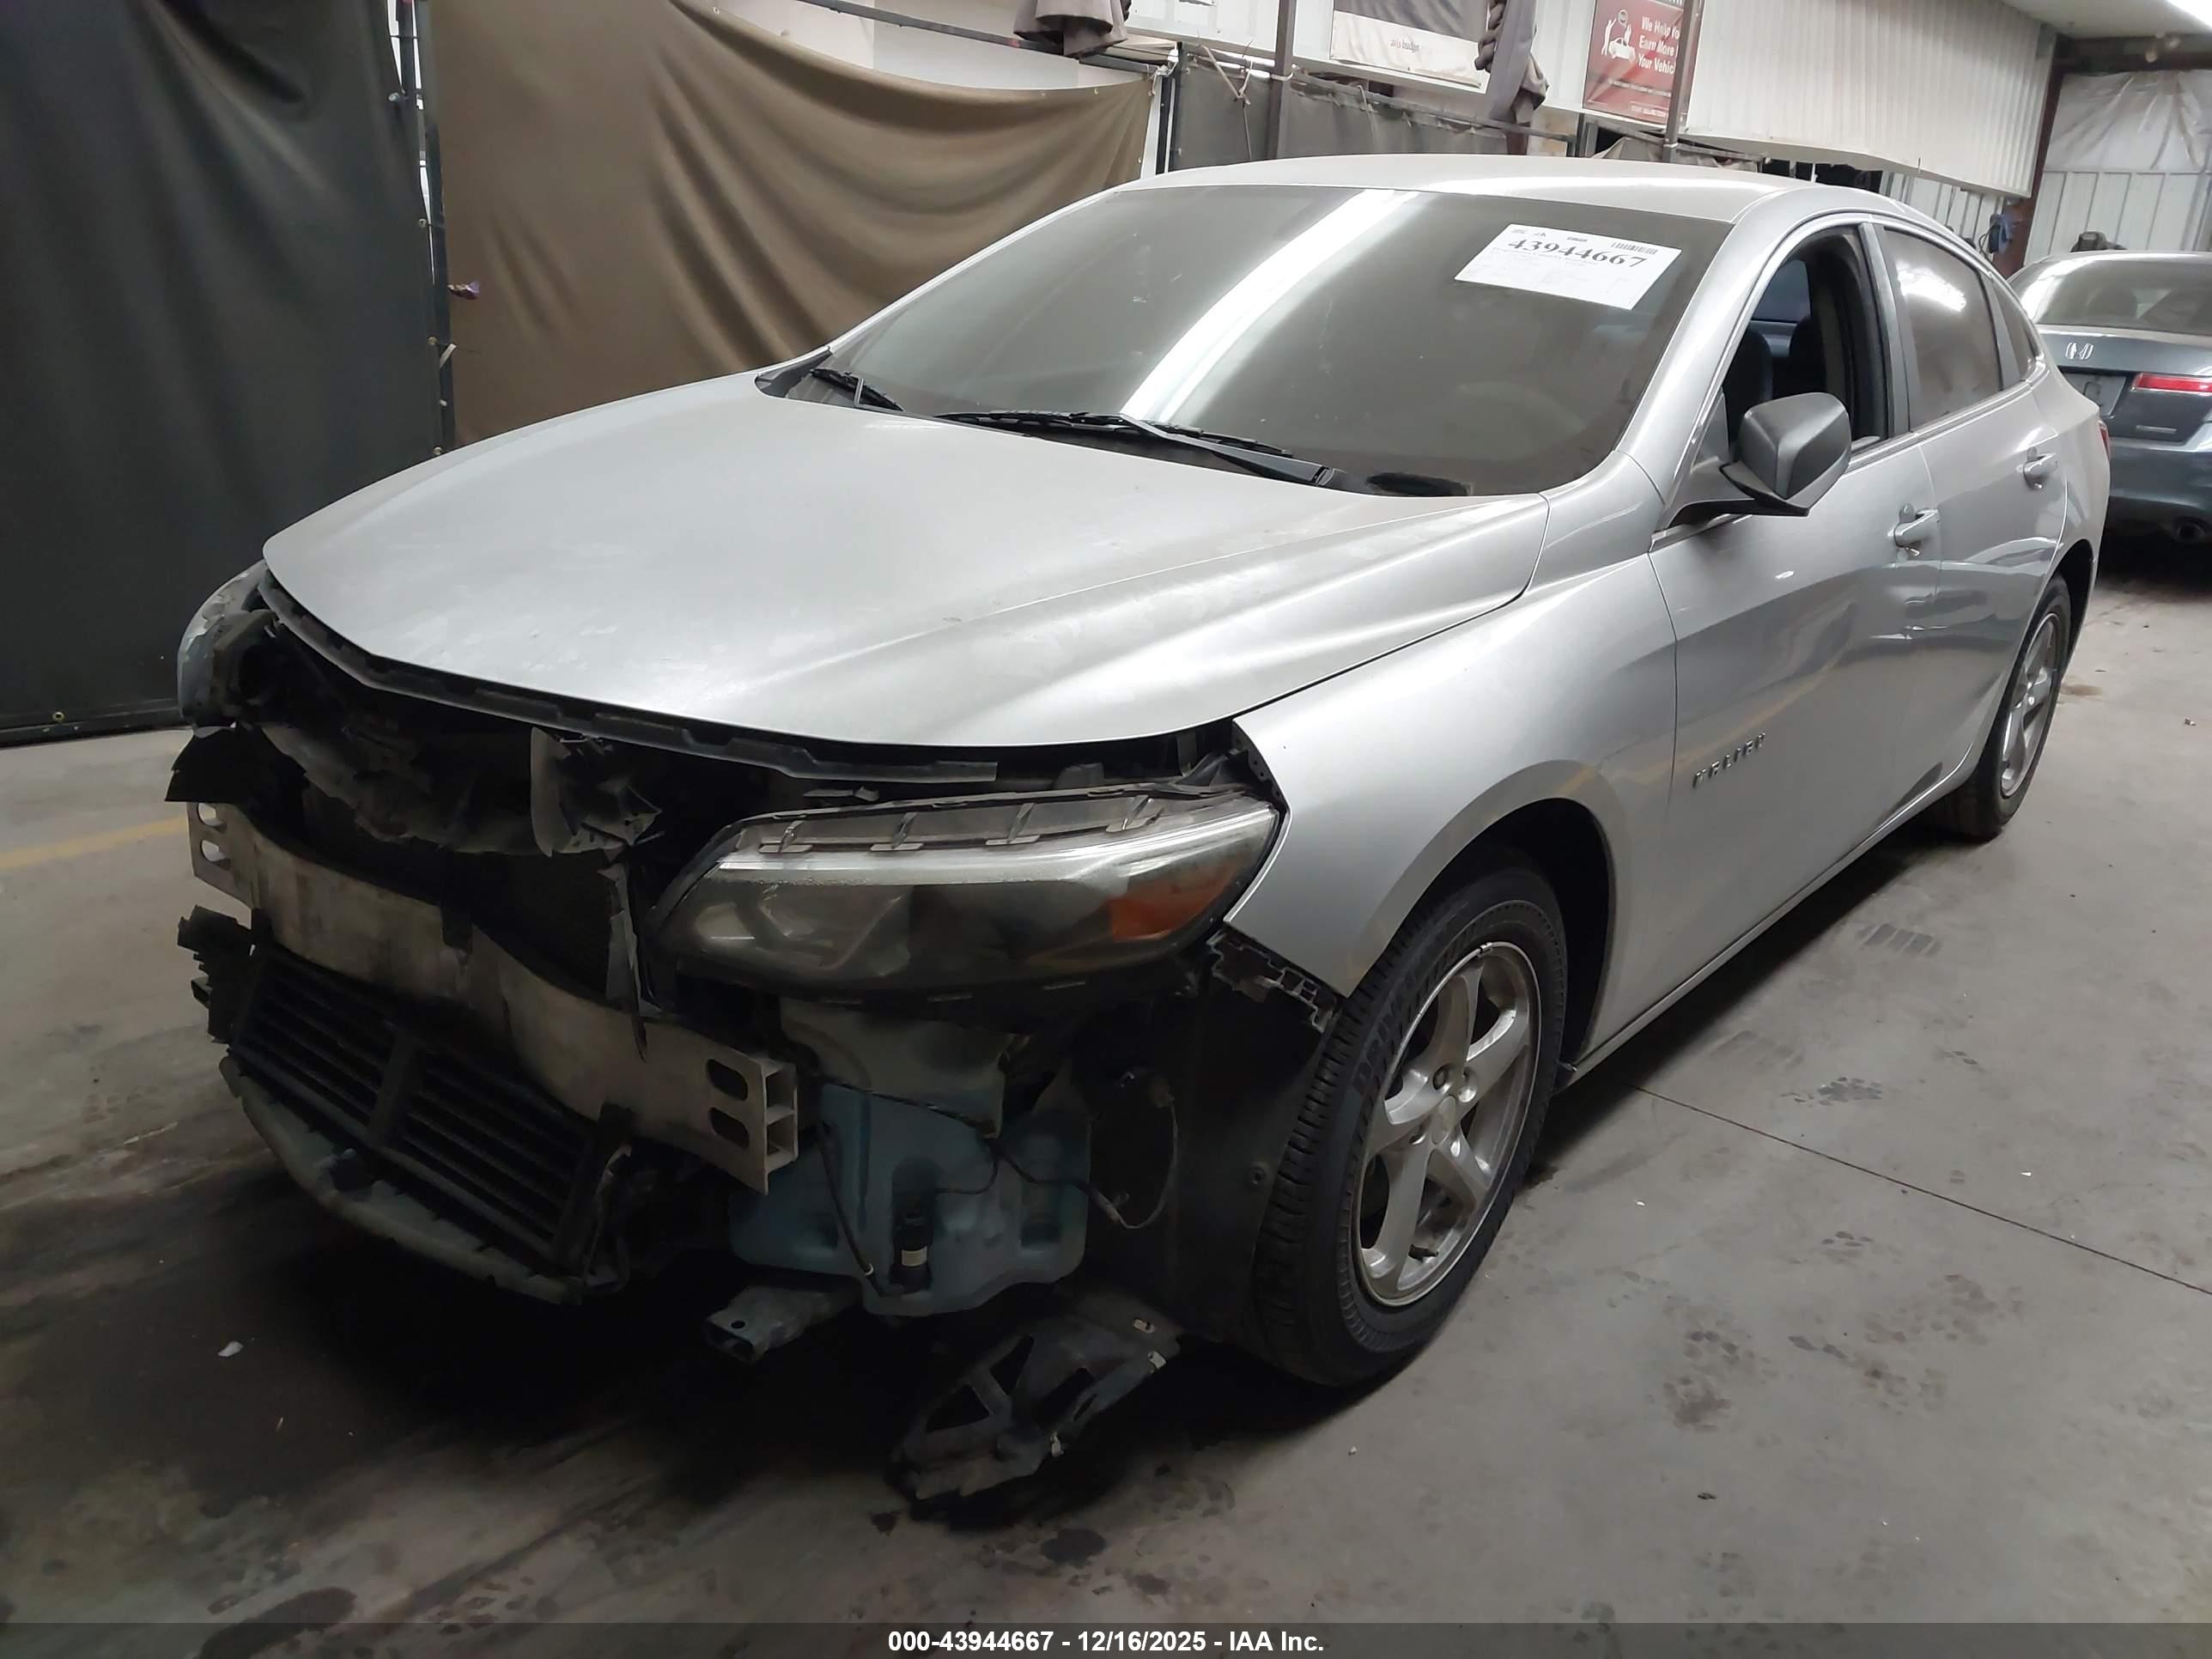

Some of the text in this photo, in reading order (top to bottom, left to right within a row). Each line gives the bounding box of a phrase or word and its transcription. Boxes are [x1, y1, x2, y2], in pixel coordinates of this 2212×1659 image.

[1641, 15, 1652, 32] We
[1639, 33, 1657, 51] Earn
[1656, 39, 1674, 57] More
[1638, 52, 1653, 70] Your
[1508, 238, 1647, 268] 43944667
